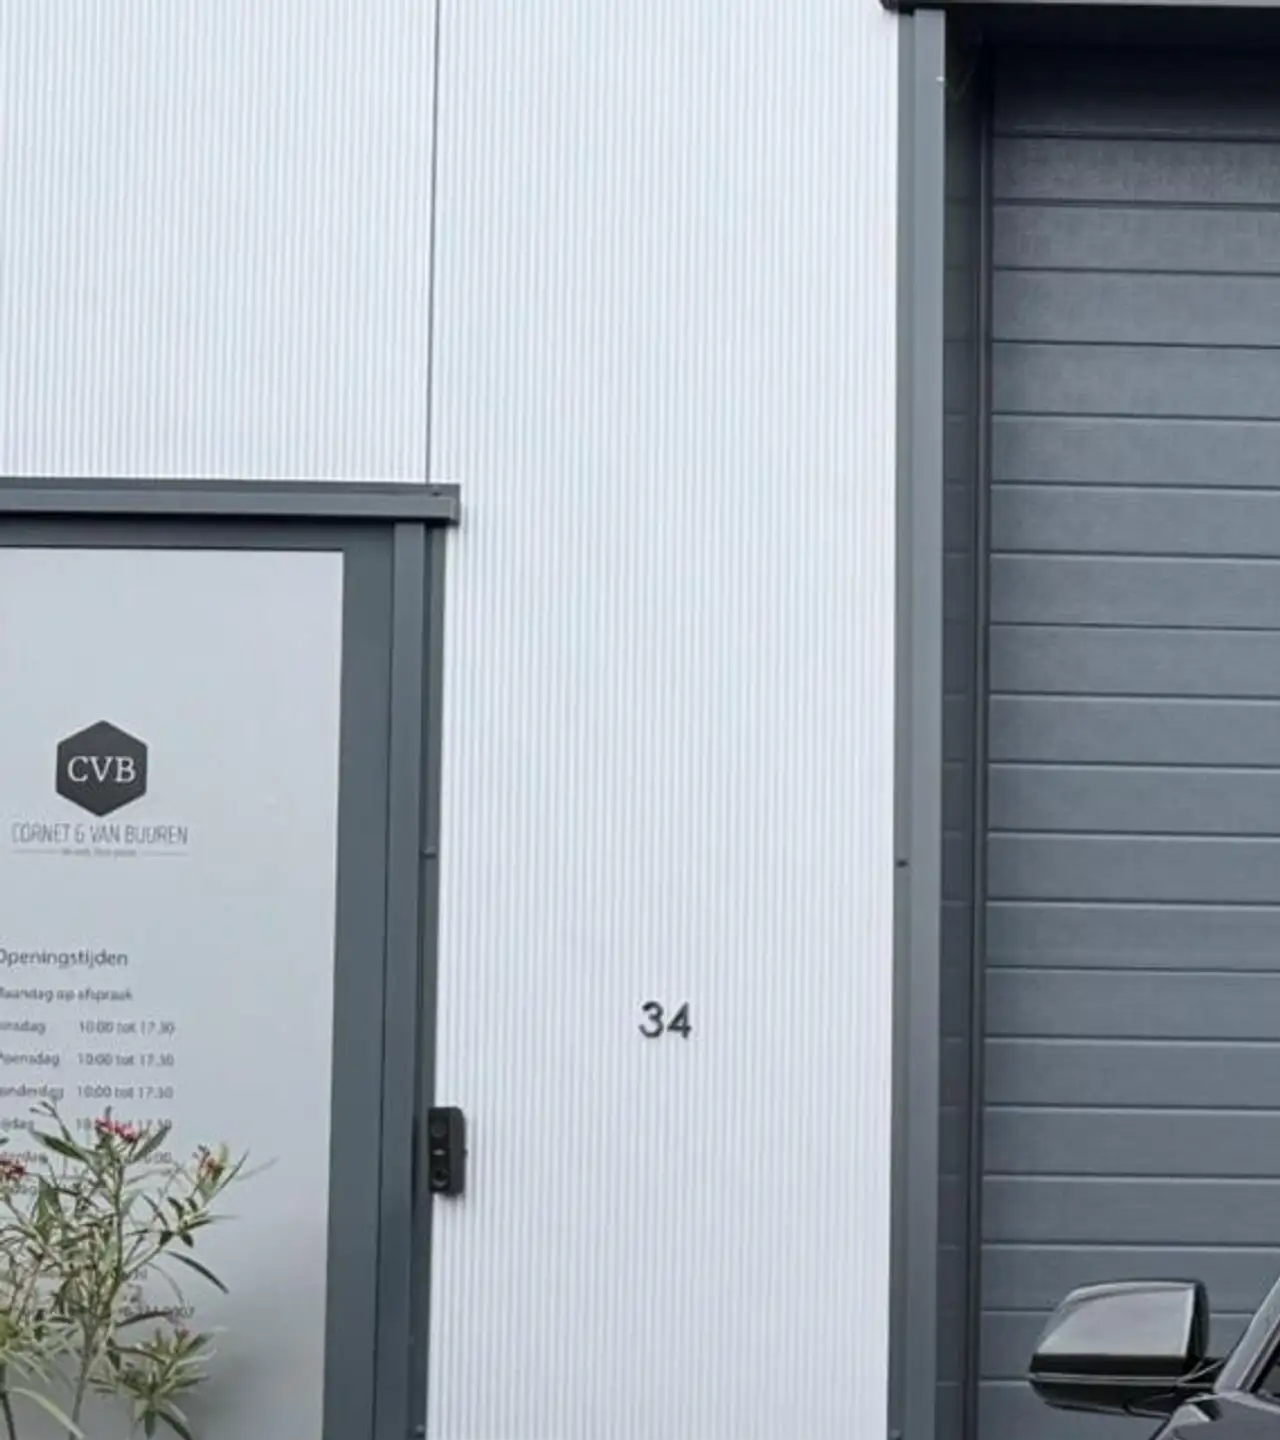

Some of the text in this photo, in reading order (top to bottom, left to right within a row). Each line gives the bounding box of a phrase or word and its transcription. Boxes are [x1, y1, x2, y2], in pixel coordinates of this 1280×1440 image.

[67, 755, 137, 783] CVB
[11, 822, 71, 845] CORNET
[89, 824, 121, 845] VAN
[124, 824, 188, 846] BUUREN
[638, 1001, 692, 1040] 34
